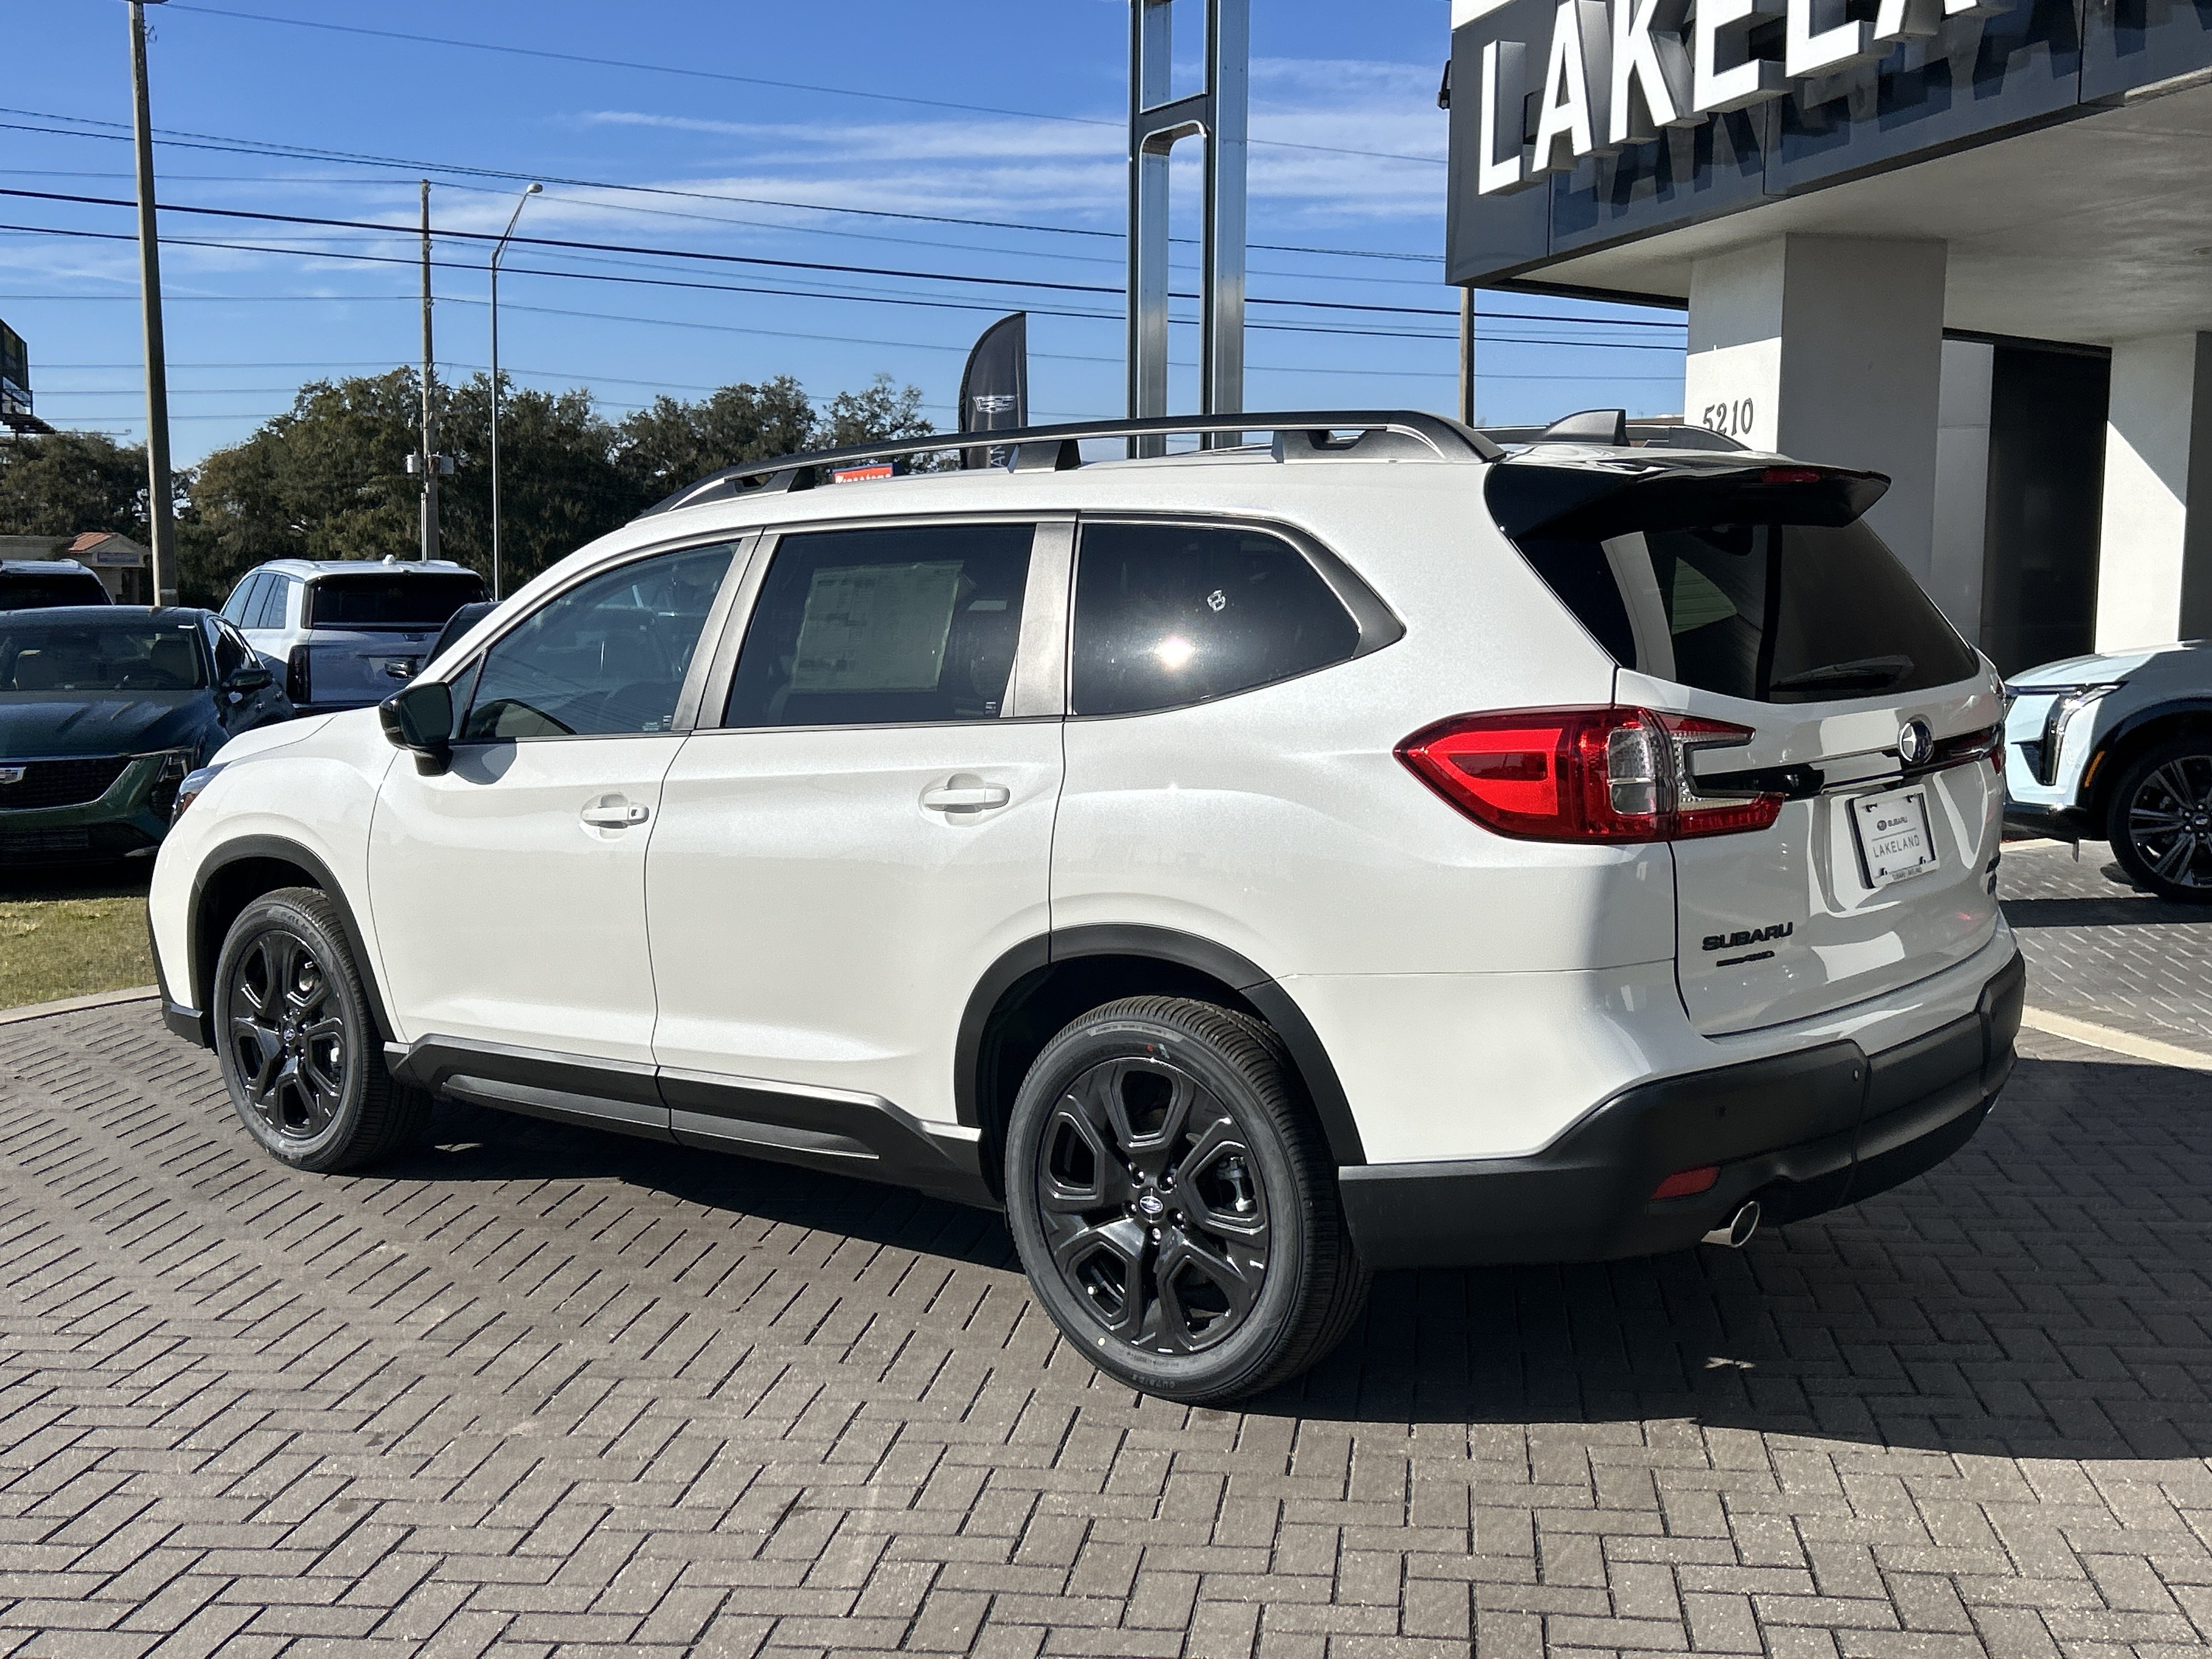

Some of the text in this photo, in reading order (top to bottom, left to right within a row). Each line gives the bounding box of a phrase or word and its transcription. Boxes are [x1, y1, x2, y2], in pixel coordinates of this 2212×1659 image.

[1703, 398, 1753, 436] 5210
[1873, 834, 1920, 857] LAKELAND
[1702, 921, 1793, 951] SUBARU
